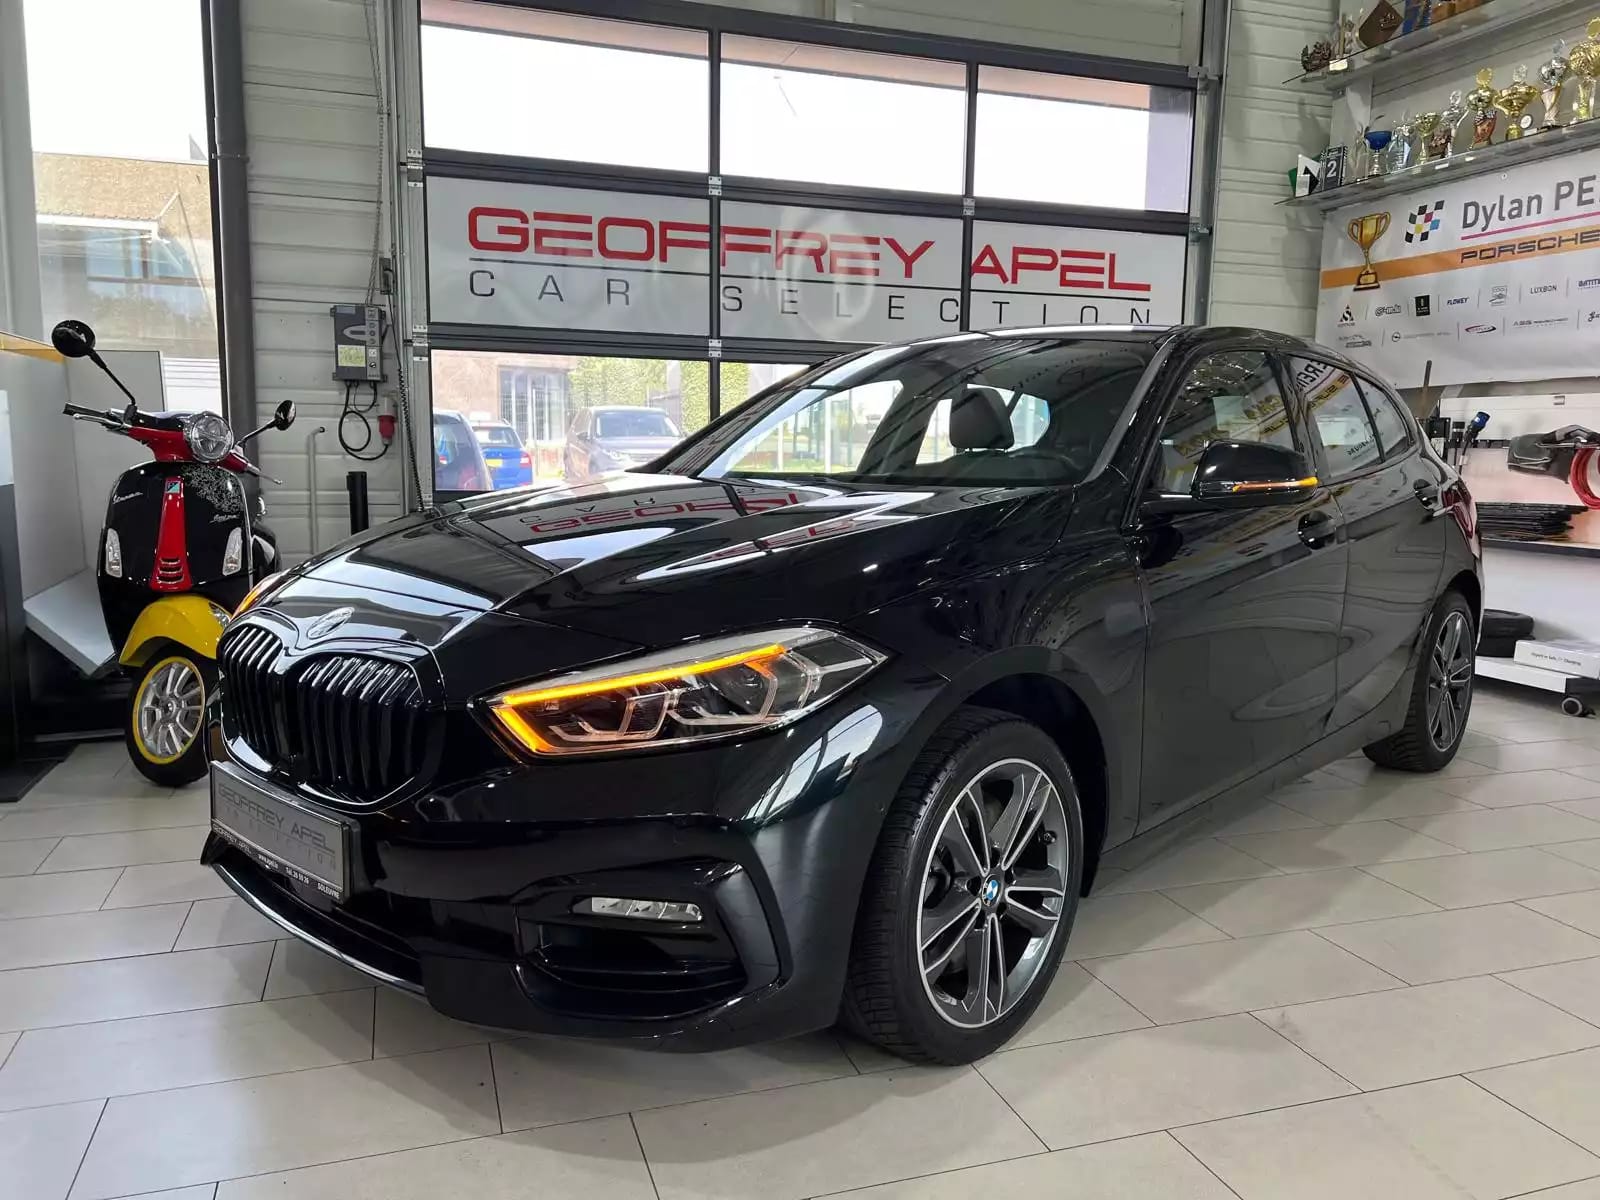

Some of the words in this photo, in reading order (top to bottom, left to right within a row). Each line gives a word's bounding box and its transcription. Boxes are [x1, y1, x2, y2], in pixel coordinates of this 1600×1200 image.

[1326, 160, 1337, 178] 2
[1462, 194, 1543, 232] Dylan
[1554, 174, 1600, 211] PE
[468, 206, 935, 278] GEOFFREY
[971, 244, 1151, 291] APEL
[1460, 229, 1600, 263] PORSCHE
[469, 270, 630, 305] CAR
[722, 285, 1150, 324] SELECTION
[218, 783, 285, 829] GEOFFREY
[291, 823, 335, 855] APEL
